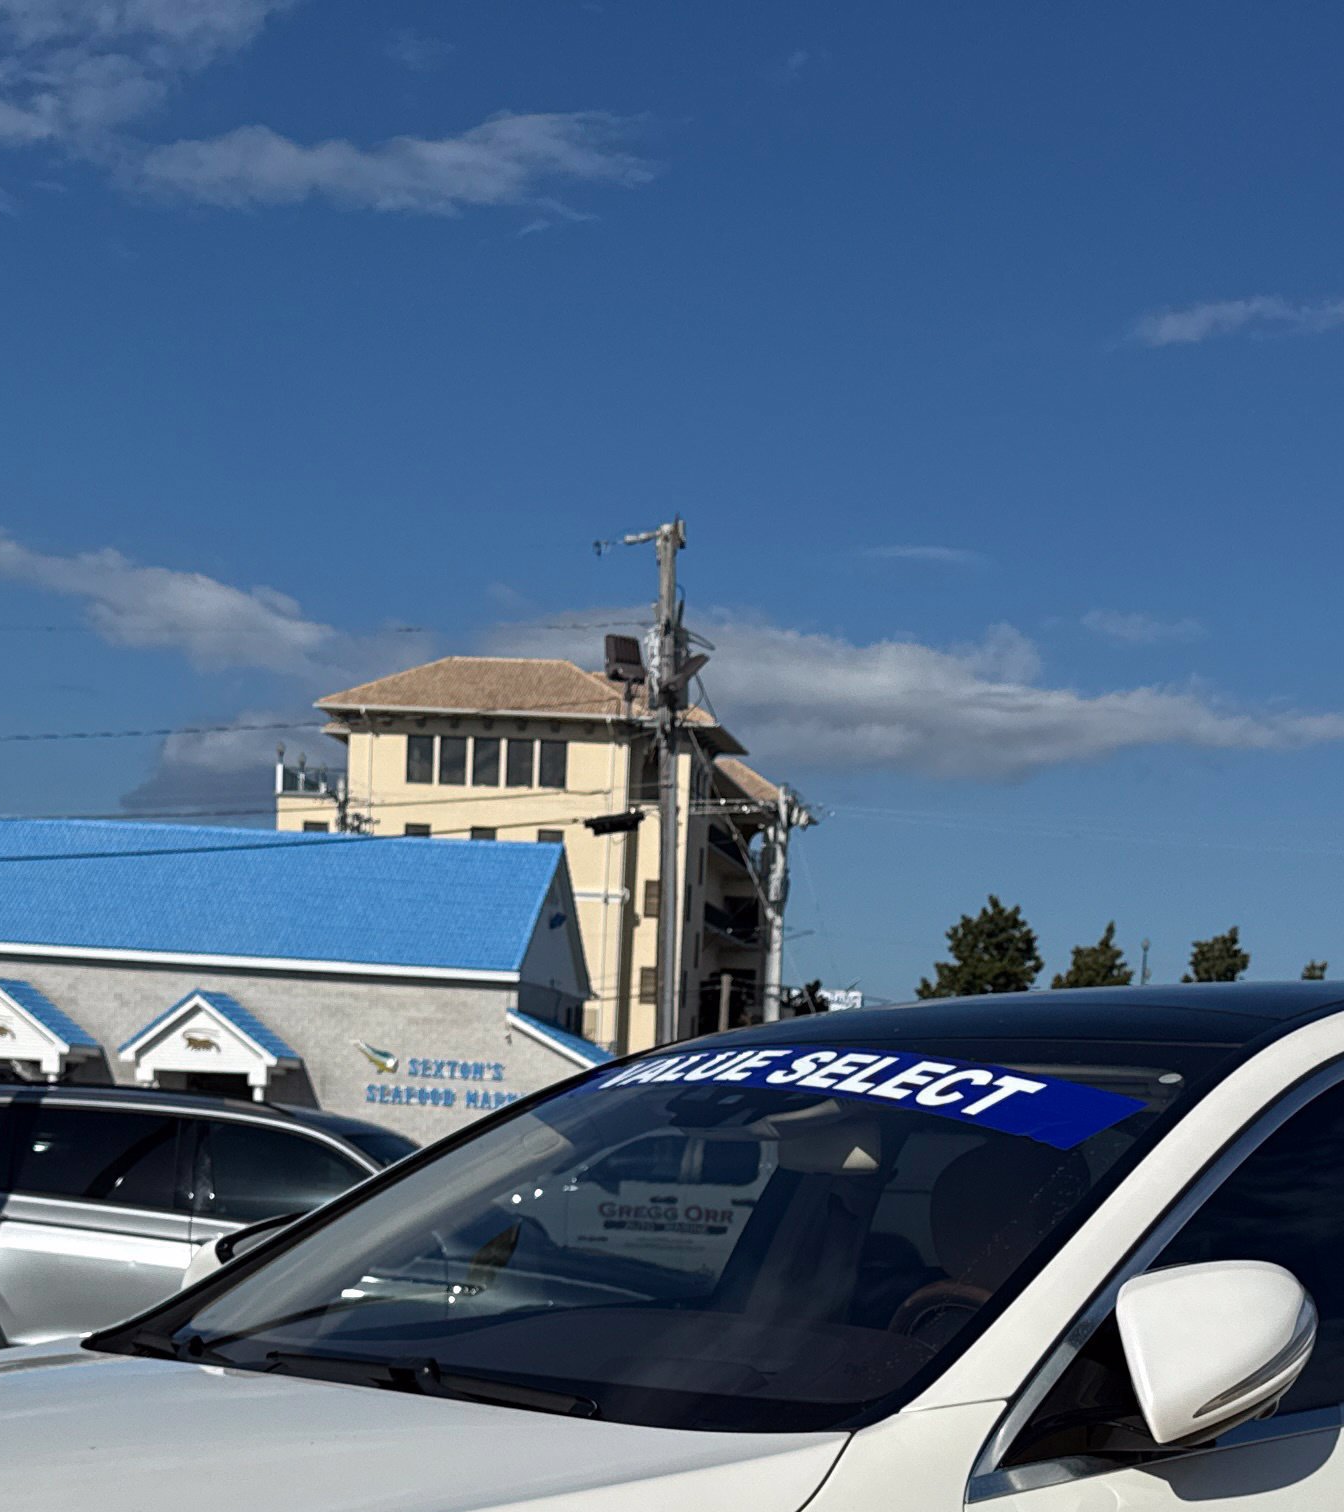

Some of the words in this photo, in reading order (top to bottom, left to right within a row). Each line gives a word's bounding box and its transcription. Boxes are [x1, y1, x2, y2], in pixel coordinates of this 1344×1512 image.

[408, 1057, 506, 1081] SEXTON'S
[598, 1050, 796, 1090] VALUE
[765, 1051, 1048, 1116] SELECT
[366, 1084, 456, 1107] SEAFOOD
